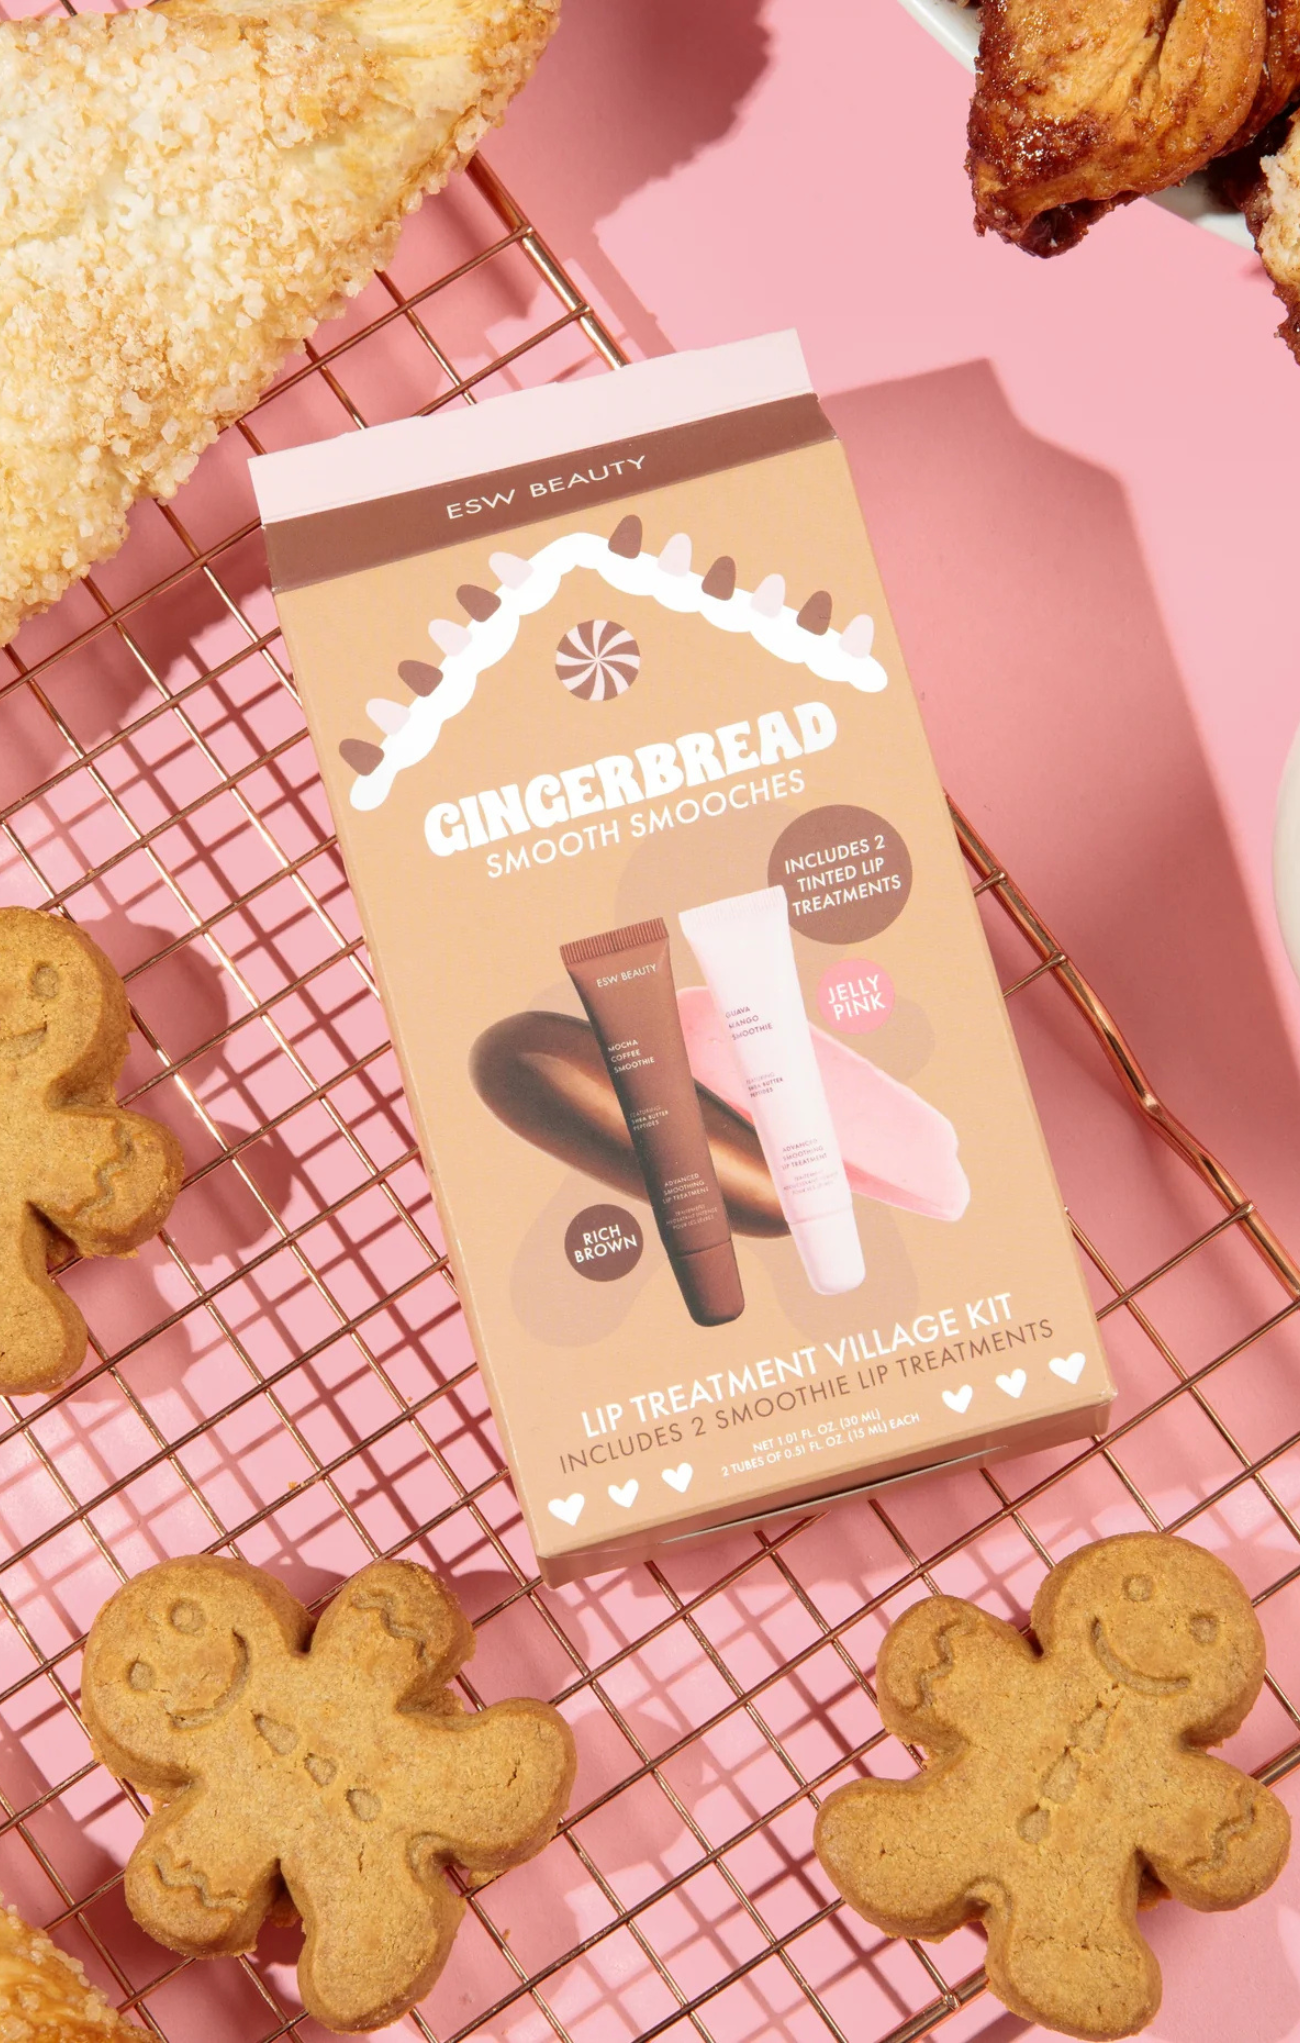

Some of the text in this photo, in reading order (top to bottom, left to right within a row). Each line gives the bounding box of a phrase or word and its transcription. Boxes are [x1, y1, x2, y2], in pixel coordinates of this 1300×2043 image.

[446, 455, 645, 519] ESW BEAUTY
[424, 701, 837, 857] GINGERBREAD
[486, 769, 806, 879] SMOOTH SMOOCHES
[784, 834, 885, 875] INCLUDES 2
[797, 857, 885, 893] TINTED LIP
[792, 874, 902, 917] TREATMENTS
[596, 963, 657, 988] ESW BEAUTY
[828, 974, 880, 1004] JELLY
[725, 1006, 750, 1019] GUAVA
[833, 992, 886, 1021] PINK
[728, 1014, 759, 1029] MANGO
[731, 1022, 773, 1041] SMOOTHIE
[607, 1039, 638, 1052] MOCHA
[610, 1048, 641, 1063] COFFEE
[613, 1056, 655, 1074] SMOOTHIE
[664, 1172, 700, 1187] ADVANCED
[574, 1234, 638, 1263] BROWN
[583, 1223, 621, 1246] RICH
[581, 1292, 1012, 1438] LIP TREATMENT VILLAGE KIT
[559, 1319, 1054, 1474] INCLUDES 2 SMOOTHIE LIP TREATMENTS
[721, 1466, 729, 1477] 2
[730, 1456, 765, 1475] TUBES
[766, 1450, 782, 1464] OF
[784, 1446, 806, 1460] 0.51
[825, 1433, 846, 1448] OZ.
[848, 1428, 865, 1443] (15
[867, 1421, 888, 1436] ML)
[889, 1413, 920, 1430] EACH
[752, 1438, 774, 1454] NET
[778, 1432, 798, 1446] 1.01
[817, 1421, 838, 1435] OZ.
[840, 1416, 859, 1431] (30
[861, 1408, 881, 1424] ML)
